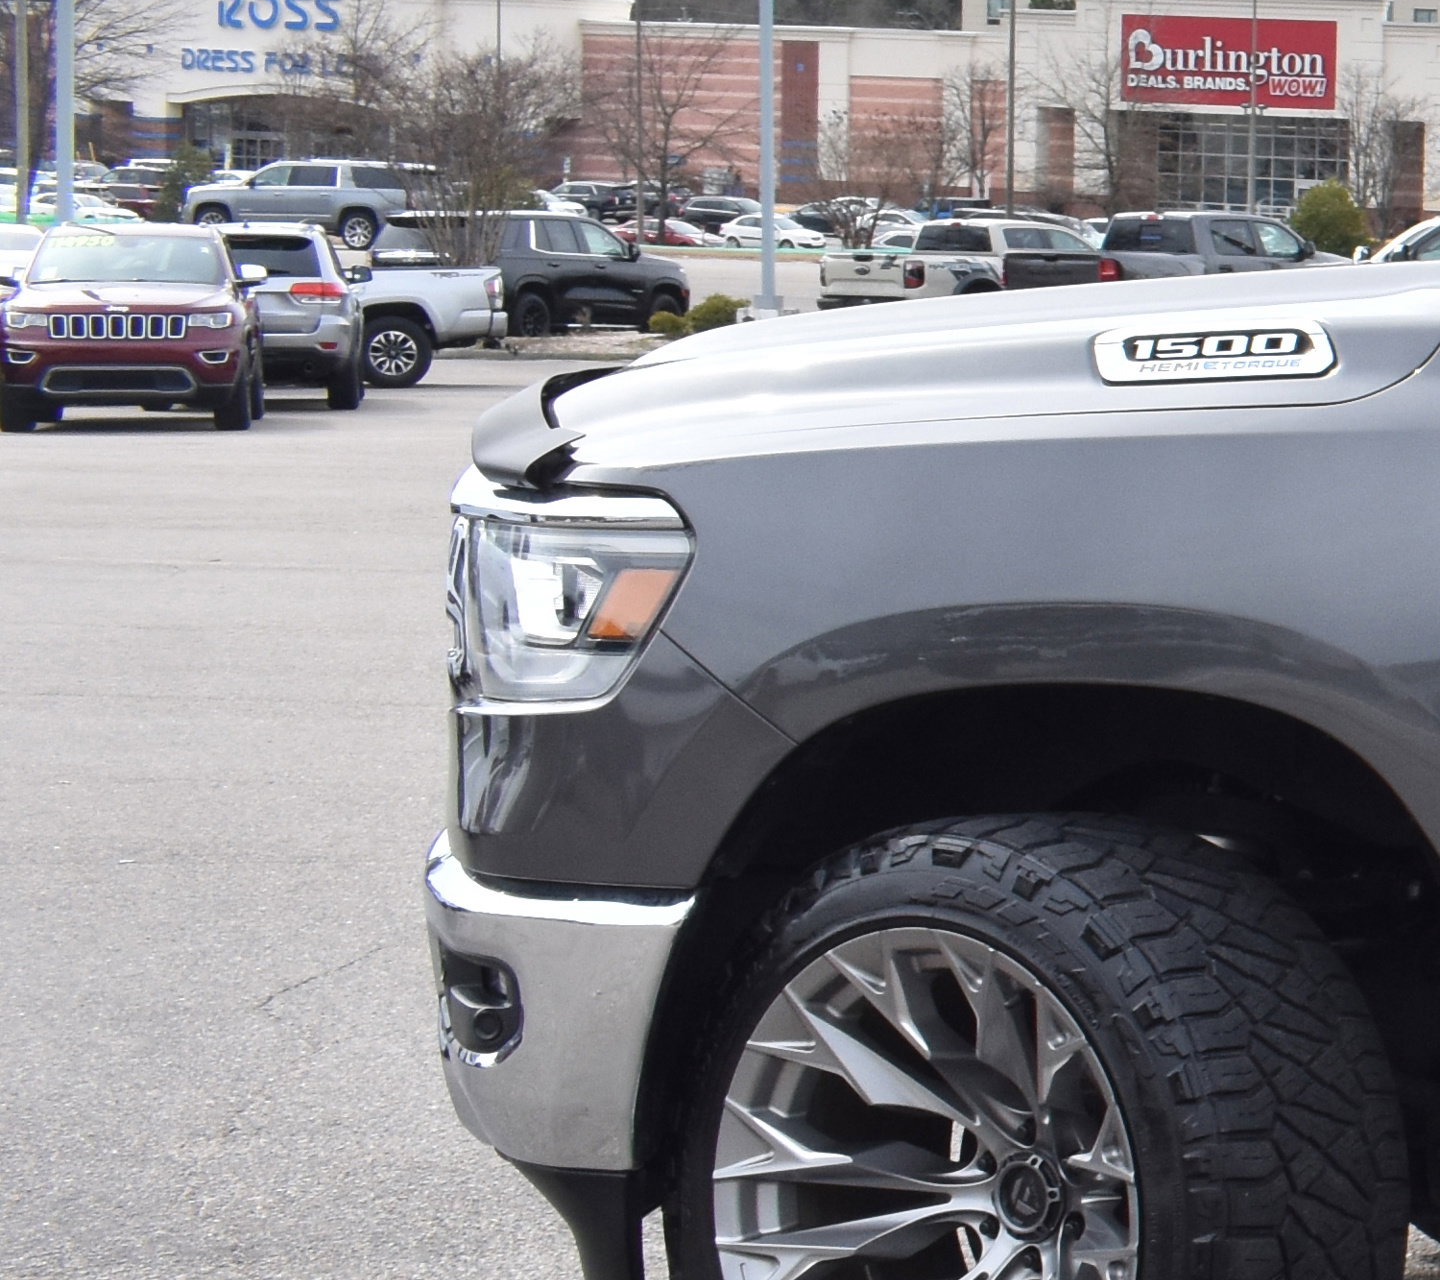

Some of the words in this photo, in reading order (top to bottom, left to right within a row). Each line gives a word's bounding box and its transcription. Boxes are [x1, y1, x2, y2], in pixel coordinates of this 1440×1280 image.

[181, 48, 255, 73] DRESS
[1128, 28, 1325, 85] Burlington
[1126, 73, 1181, 89] DEALS.
[1183, 76, 1250, 91] BRANDS.
[1269, 76, 1327, 98] WOW!
[1133, 332, 1298, 361] 1500
[1139, 362, 1198, 373] HEMI
